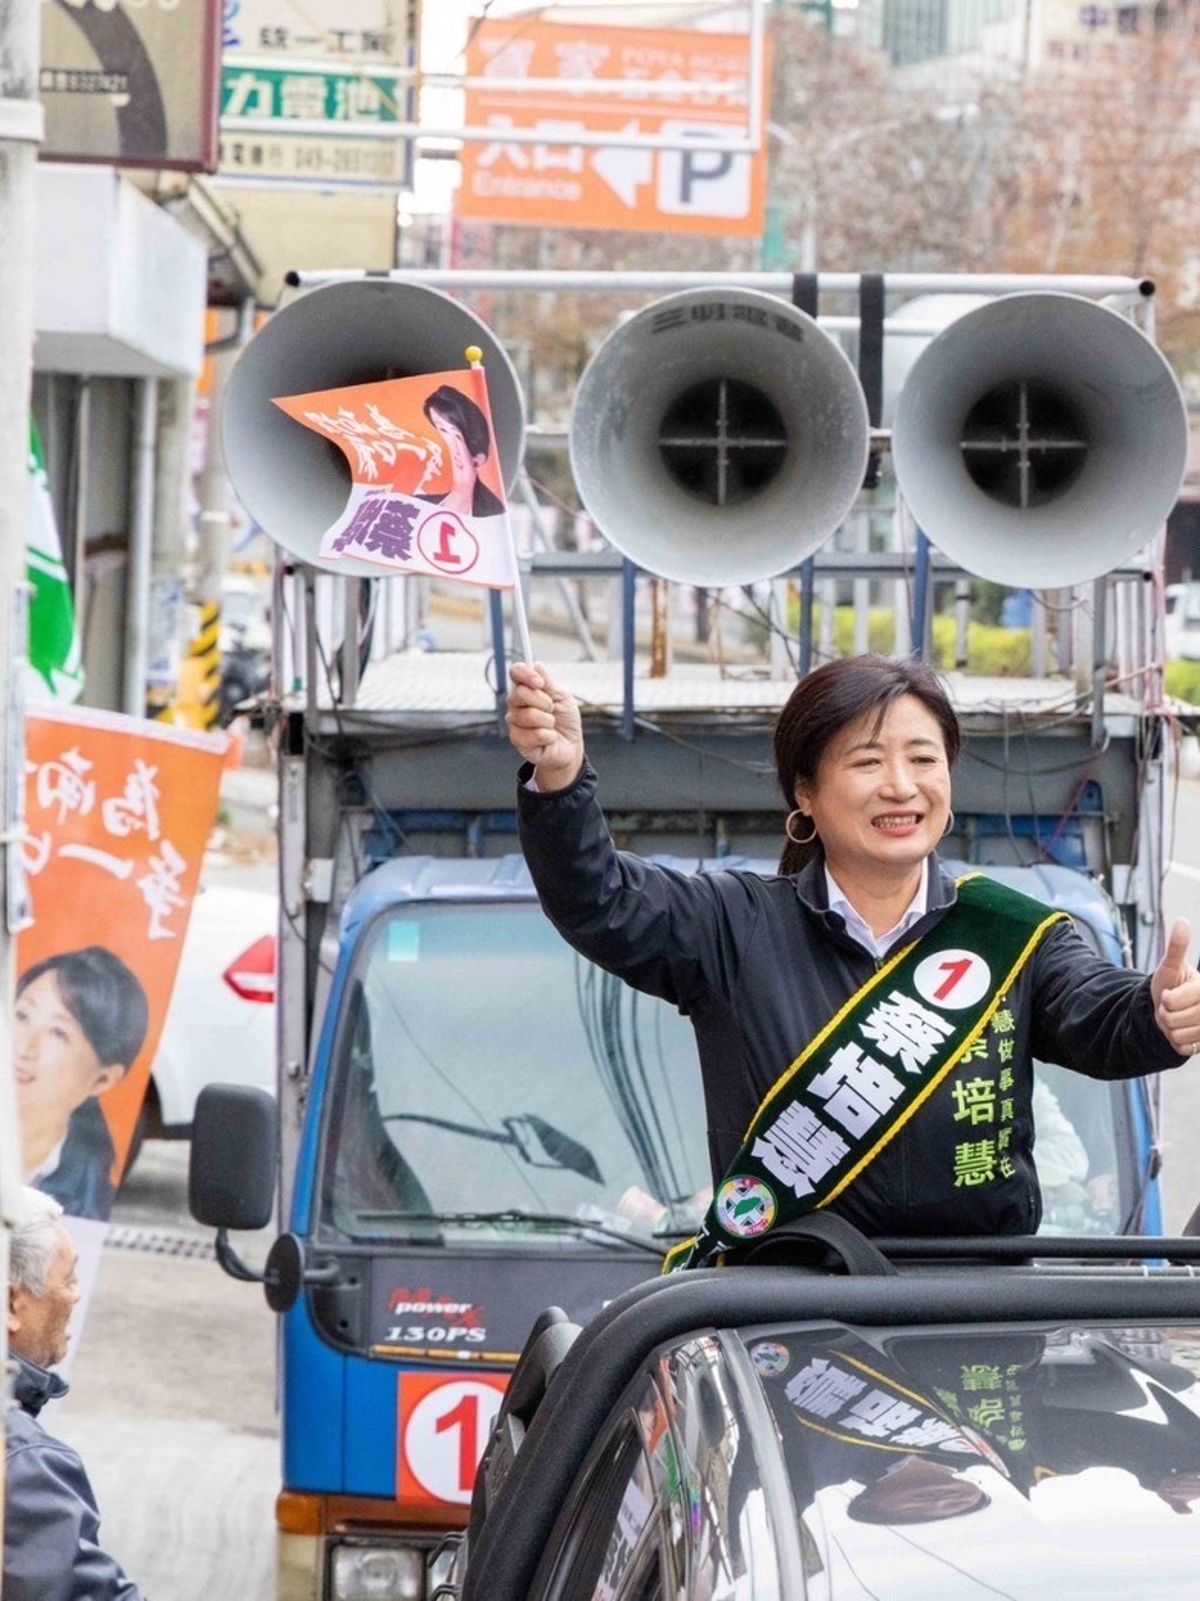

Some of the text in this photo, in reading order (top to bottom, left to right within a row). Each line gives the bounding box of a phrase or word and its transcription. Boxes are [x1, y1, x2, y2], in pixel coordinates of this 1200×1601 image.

[475, 114, 585, 171] 入口
[680, 131, 732, 203] P
[473, 170, 582, 200] Entrance
[932, 958, 974, 1001] 1
[751, 990, 957, 1199] 蔡培慧
[395, 1301, 473, 1316] power
[435, 1395, 479, 1491] 1
